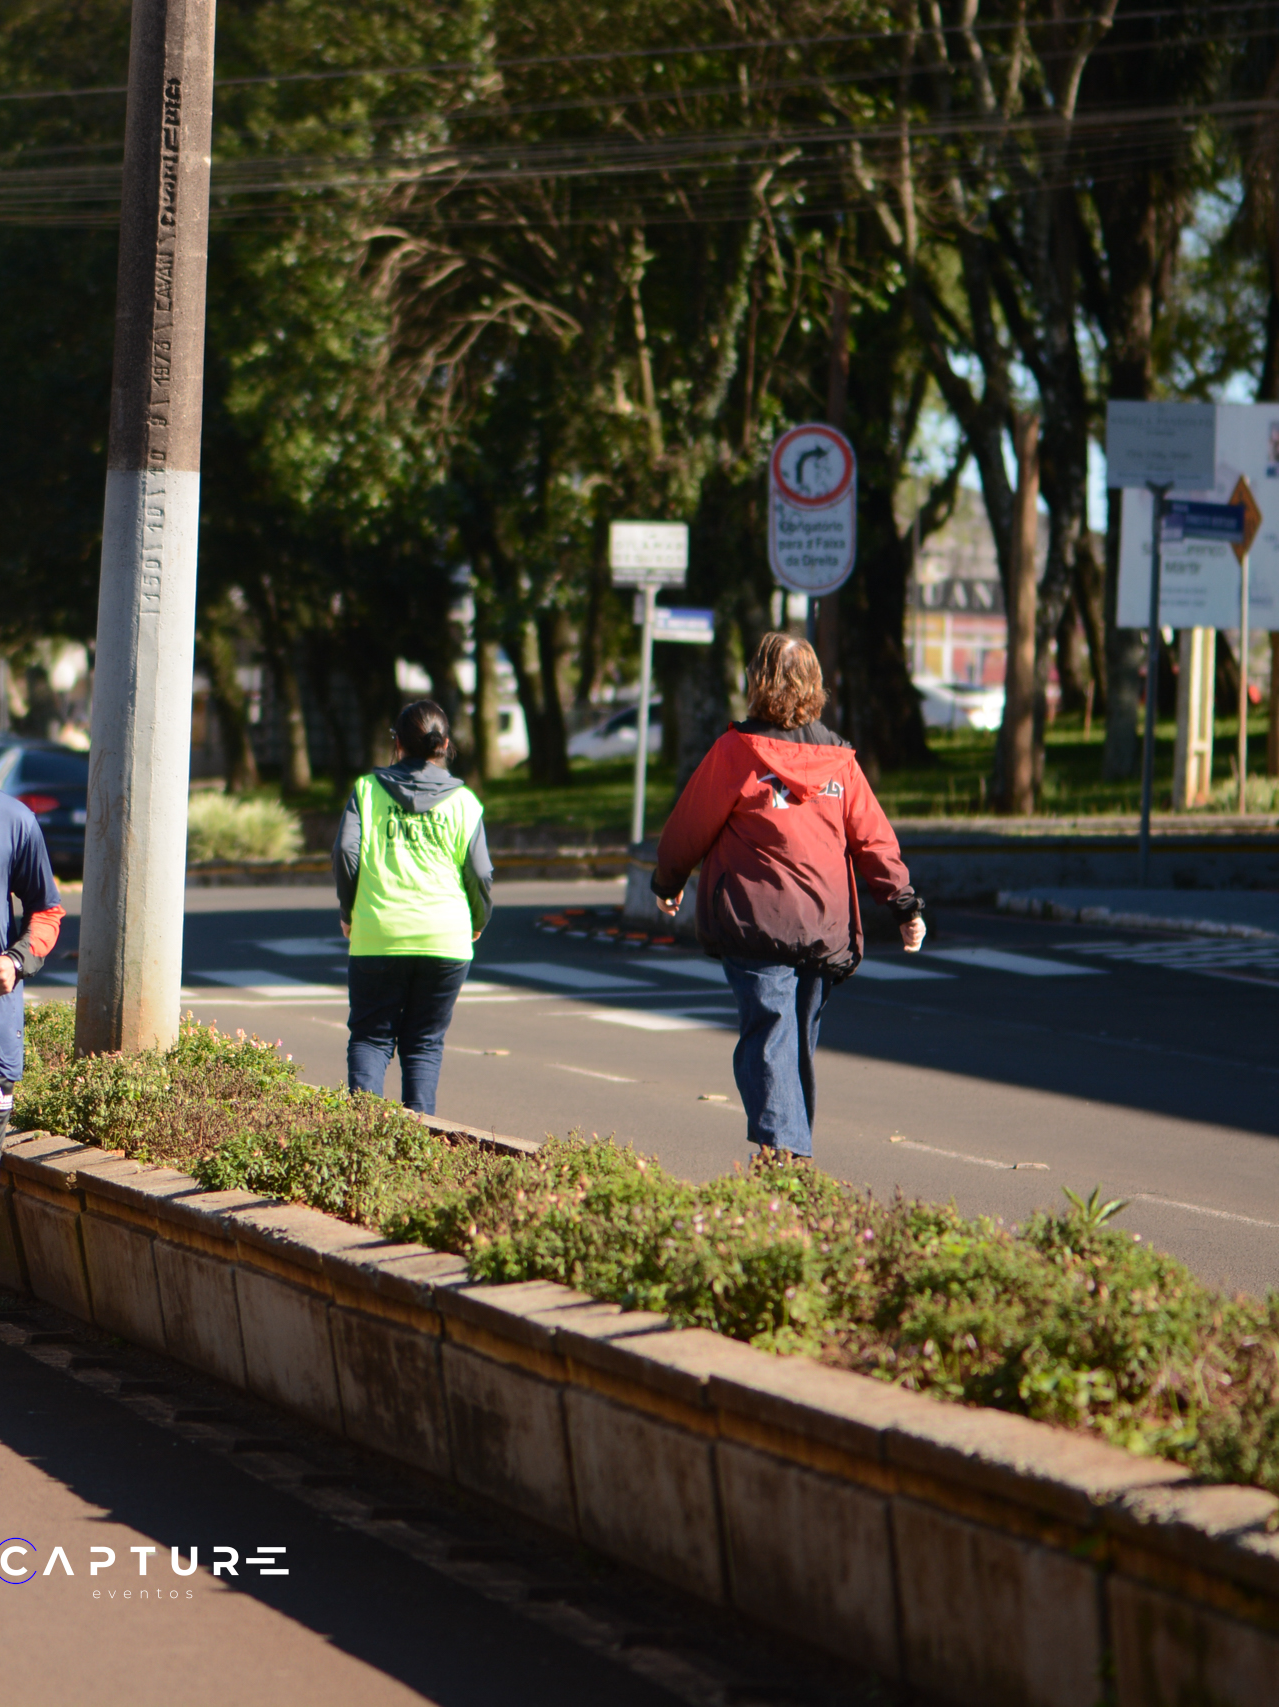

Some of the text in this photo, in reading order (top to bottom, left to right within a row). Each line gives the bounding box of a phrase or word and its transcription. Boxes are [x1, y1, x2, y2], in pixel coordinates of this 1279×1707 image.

[142, 559, 161, 602] 150
[153, 340, 171, 388] 1973
[387, 819, 419, 842] ONG
